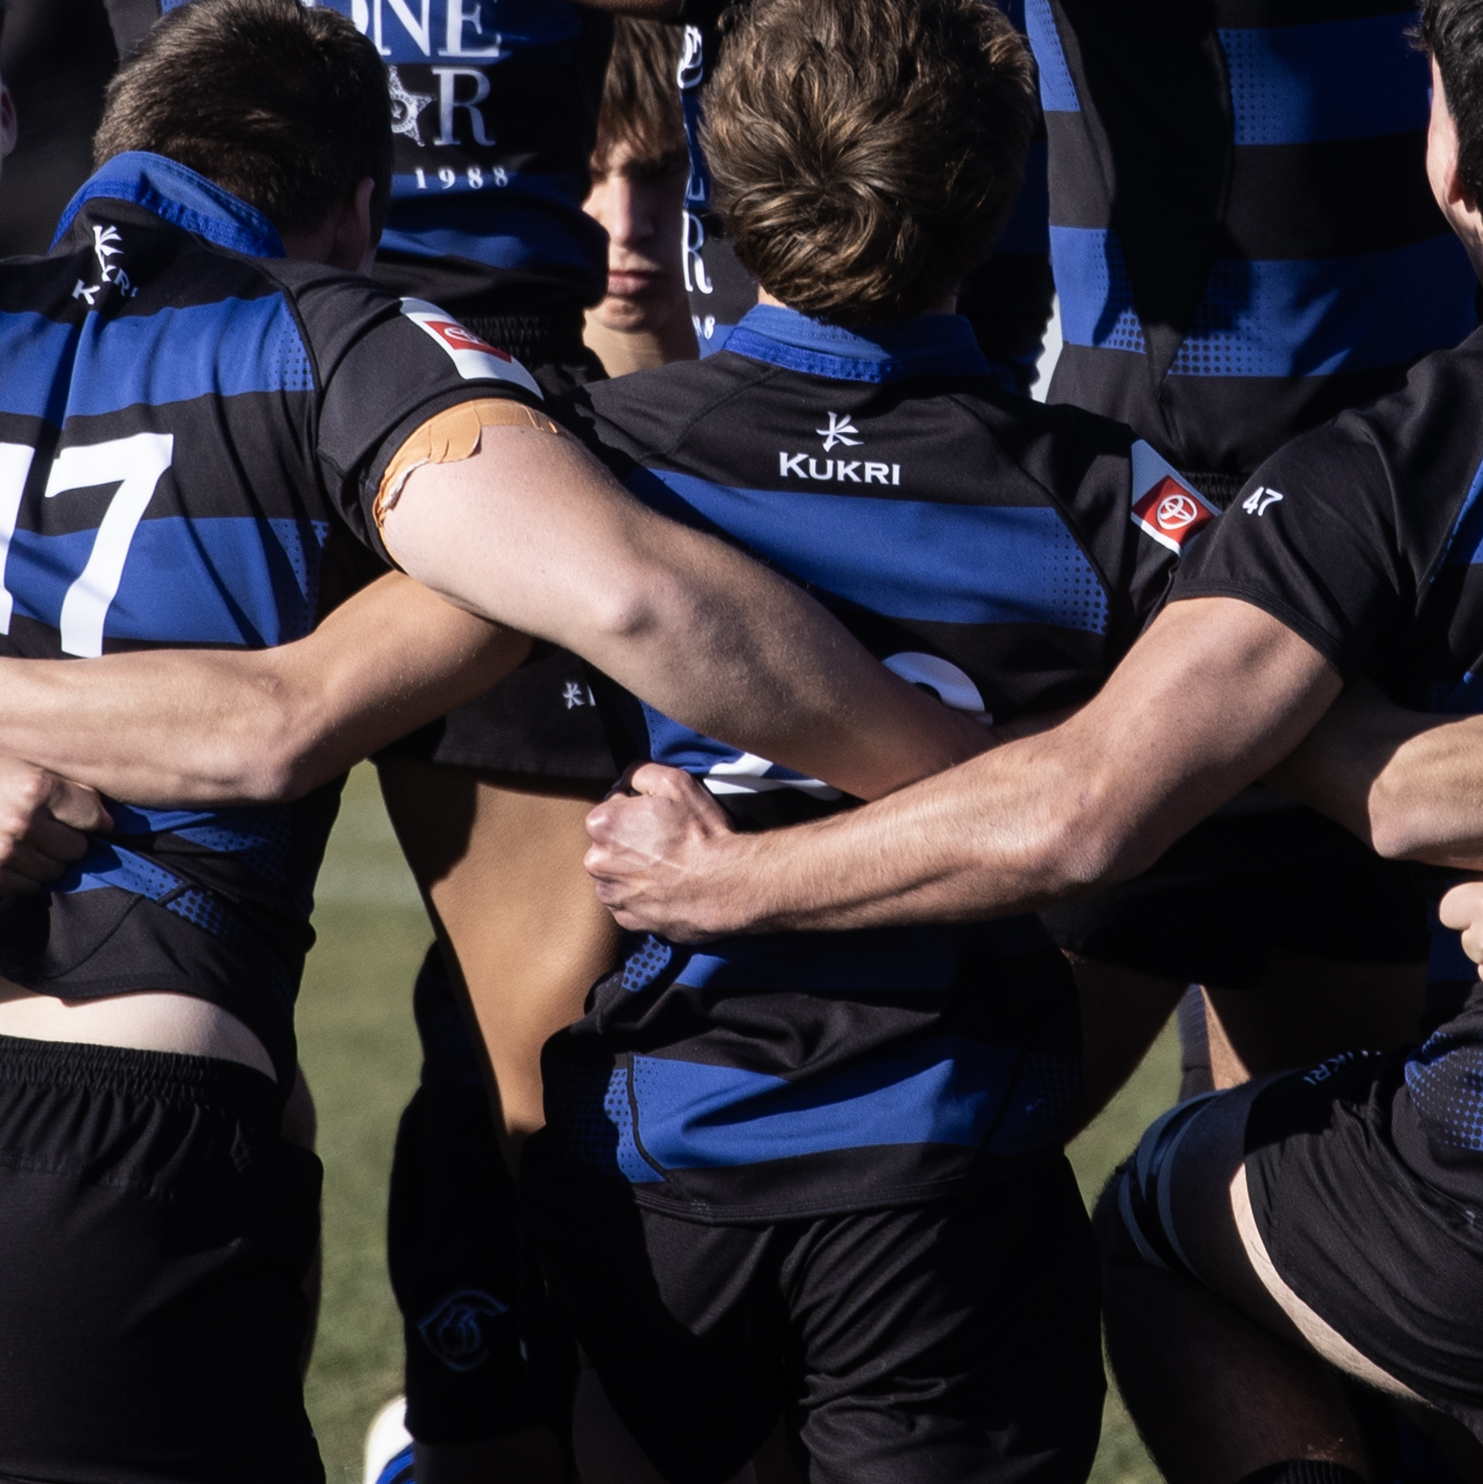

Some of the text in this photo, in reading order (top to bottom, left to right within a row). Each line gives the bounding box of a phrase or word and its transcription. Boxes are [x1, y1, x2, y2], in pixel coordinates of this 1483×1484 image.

[415, 166, 509, 190] 1988
[779, 451, 901, 486] KUKRI
[1242, 485, 1284, 517] 47
